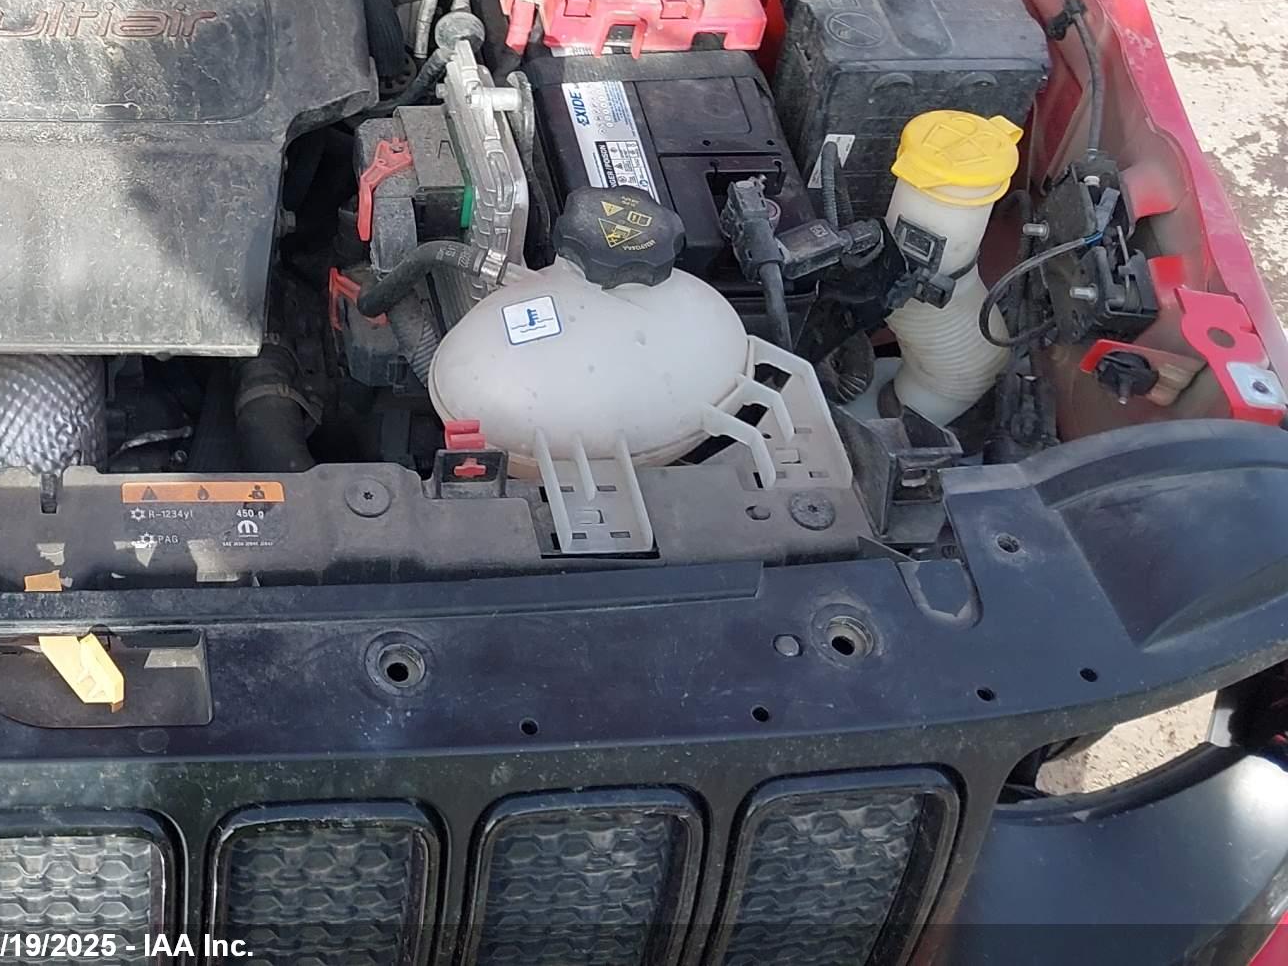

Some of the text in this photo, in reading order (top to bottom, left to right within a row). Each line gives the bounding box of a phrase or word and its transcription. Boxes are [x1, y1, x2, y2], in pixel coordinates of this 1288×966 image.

[569, 89, 590, 126] EXIDE
[236, 508, 254, 518] 450
[158, 535, 179, 544] PAG
